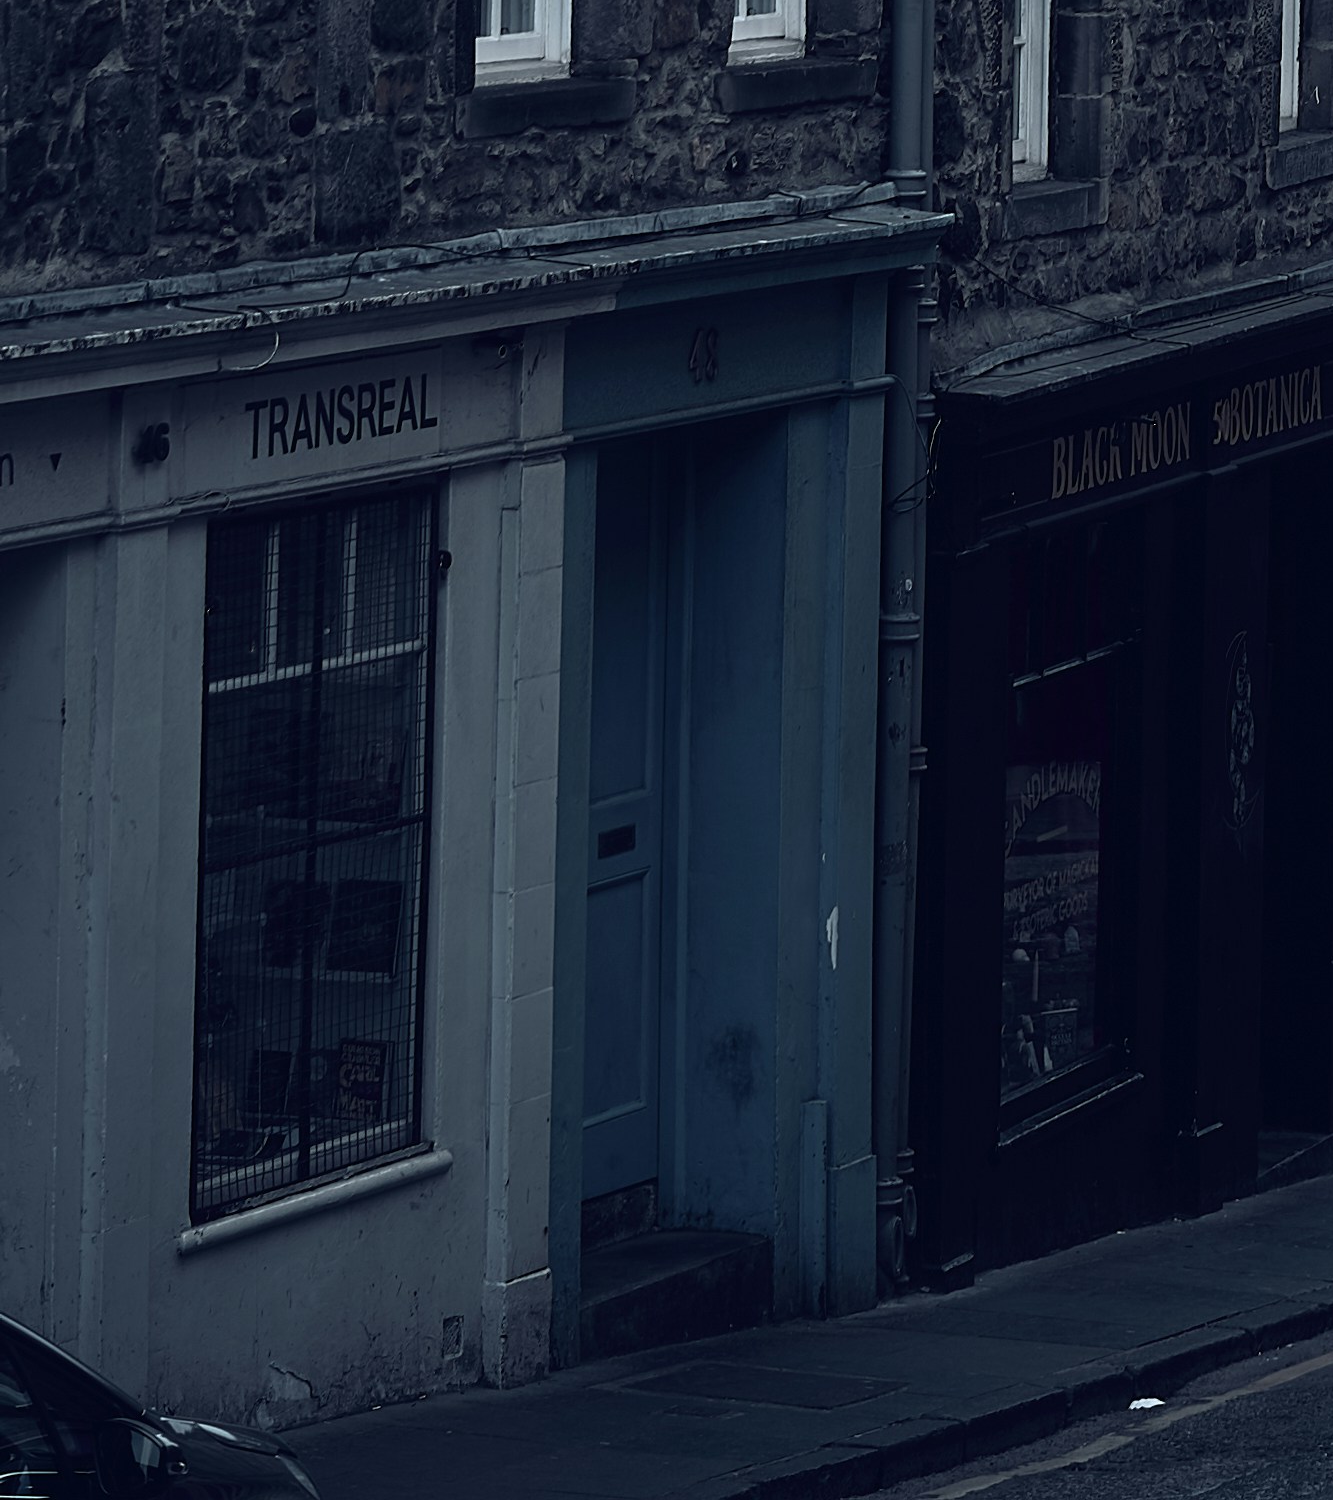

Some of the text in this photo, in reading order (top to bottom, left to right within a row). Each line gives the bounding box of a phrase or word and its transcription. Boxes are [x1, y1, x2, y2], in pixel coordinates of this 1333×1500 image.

[688, 327, 719, 384] 48
[136, 421, 170, 465] 46
[245, 373, 438, 460] TRANSREAL
[1052, 365, 1322, 500] BLACK MOON BOTANICA
[1212, 398, 1232, 446] 50
